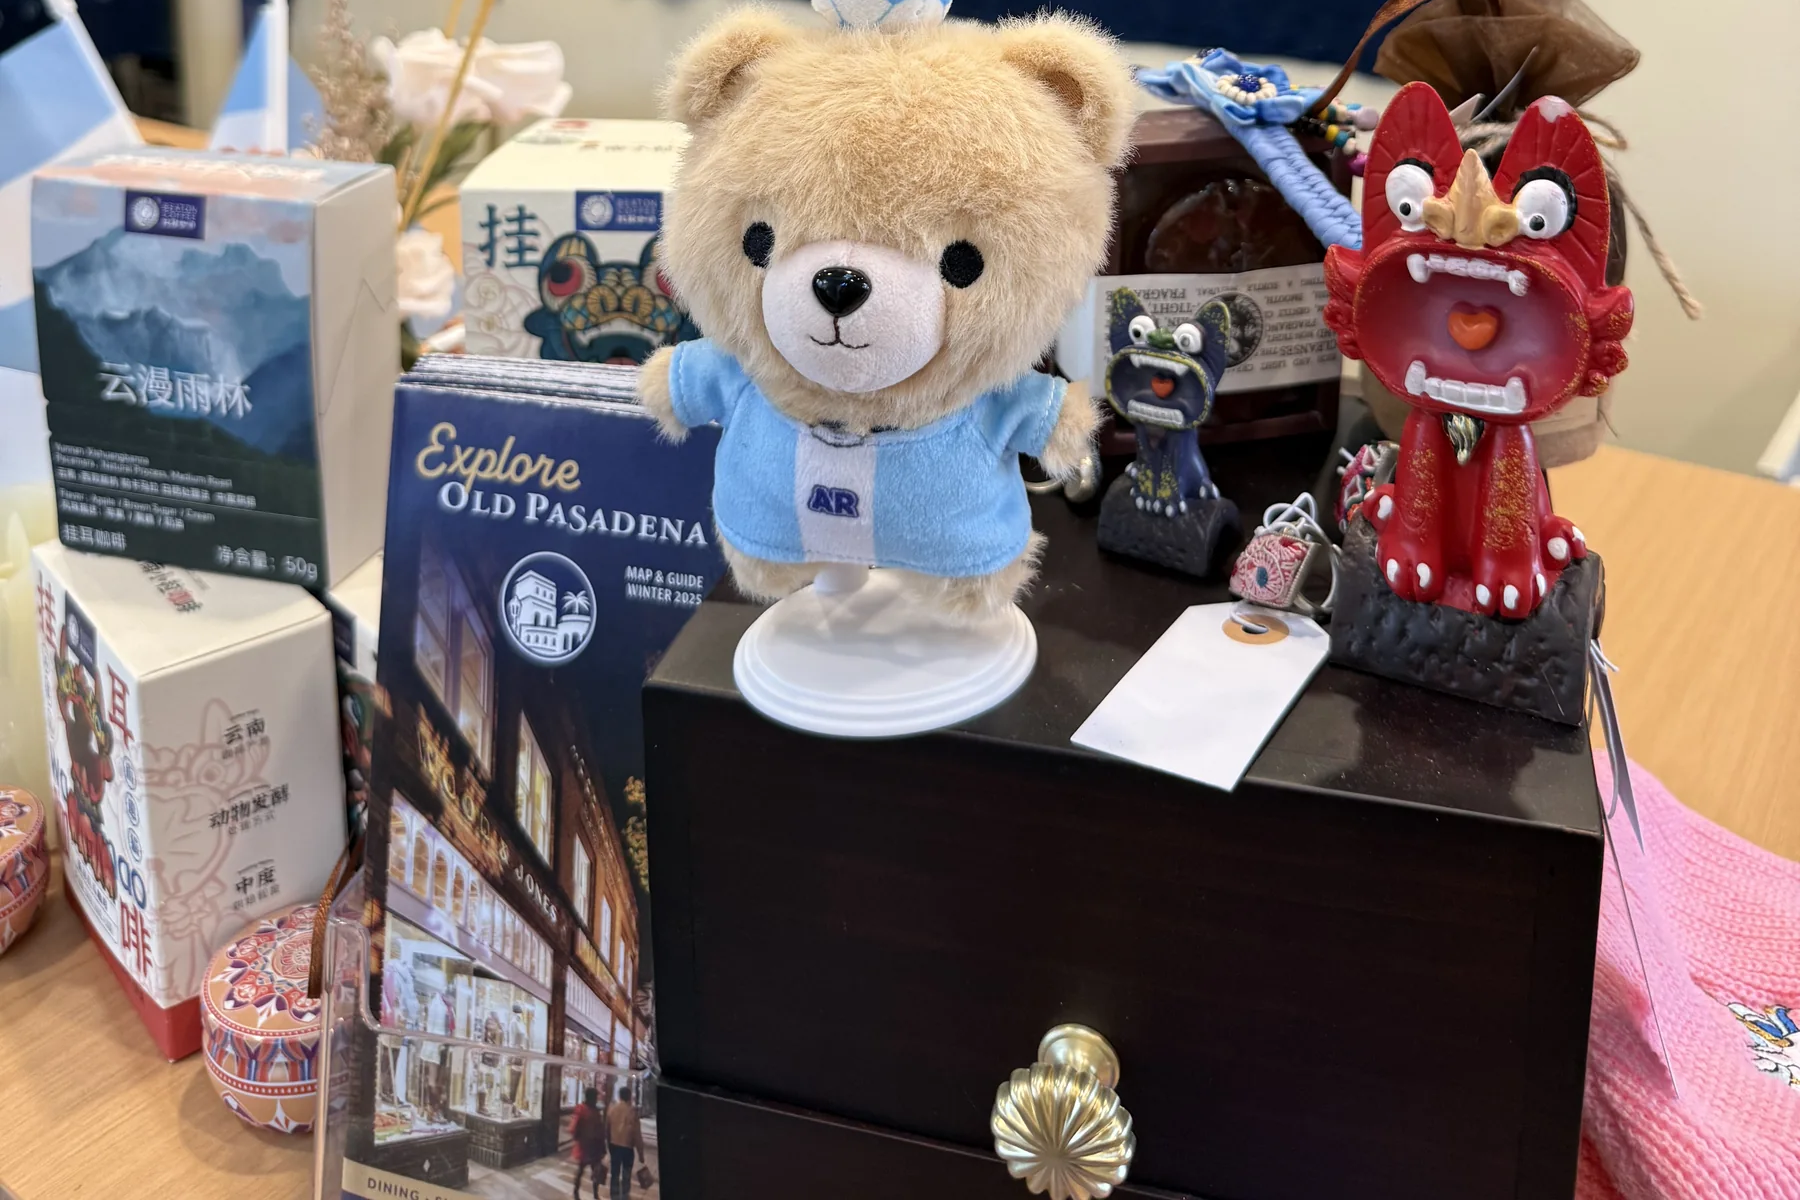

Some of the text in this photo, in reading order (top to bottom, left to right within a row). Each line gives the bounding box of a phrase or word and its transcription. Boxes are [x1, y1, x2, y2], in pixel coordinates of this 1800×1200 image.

[477, 203, 541, 269] 挂
[1104, 288, 1186, 301] FRAGRAE
[1264, 319, 1316, 332] FRAGRANC
[98, 360, 253, 420] 云漫雨林
[416, 422, 581, 494] Explore
[438, 481, 708, 545] OLD PASADENA
[807, 484, 860, 518] AR
[281, 555, 318, 583] 50g
[624, 565, 704, 589] MAP & GUIDE
[625, 582, 703, 606] WINTER 2025
[107, 662, 135, 751] 耳
[224, 717, 266, 746] 云南
[235, 866, 276, 894] 中度
[514, 863, 557, 924] JONES
[120, 896, 153, 978] 啡
[367, 1177, 419, 1200] DINING
